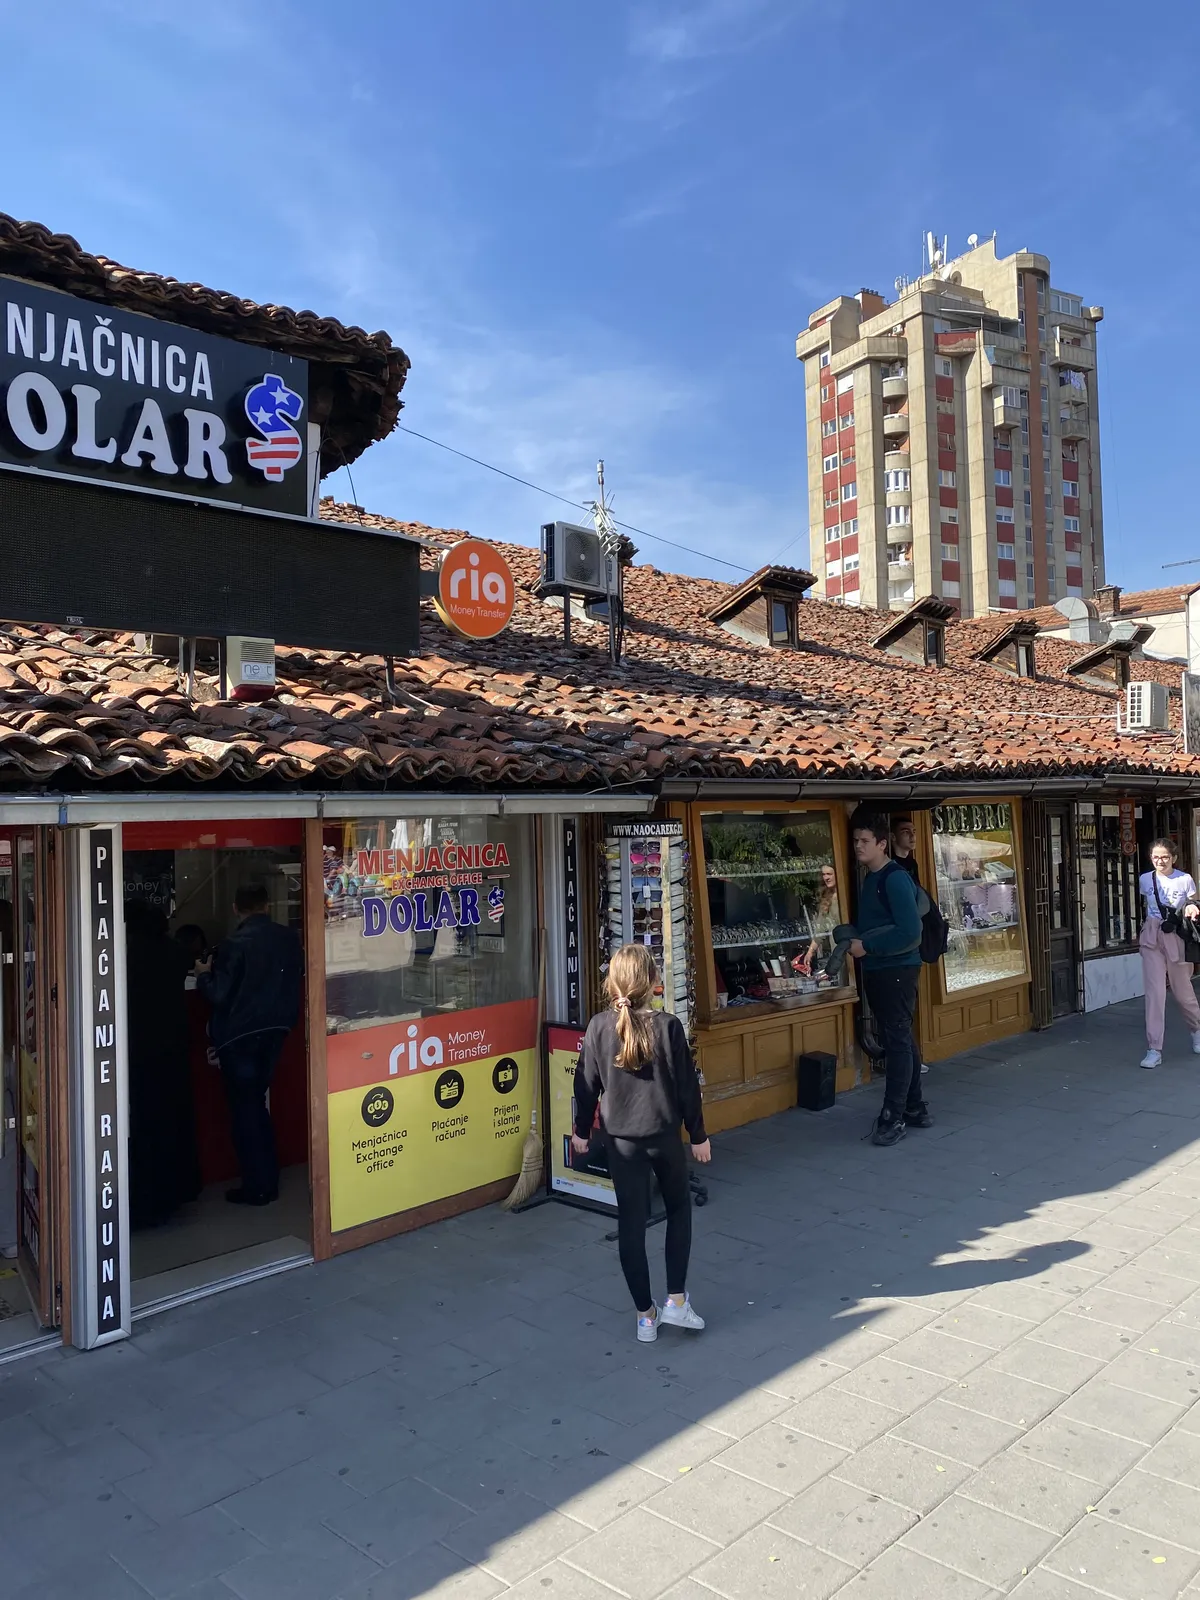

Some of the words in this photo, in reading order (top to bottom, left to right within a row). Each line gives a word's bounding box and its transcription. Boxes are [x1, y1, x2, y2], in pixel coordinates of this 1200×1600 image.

[7, 302, 213, 400] NJAČNICA
[7, 371, 232, 484] OLAR
[450, 552, 506, 604] ria
[450, 604, 476, 617] Money
[476, 606, 506, 619] Transfer
[934, 804, 1006, 833] SREBRO
[357, 839, 510, 876] MENJAČNICA
[392, 875, 448, 891] EXCHANGE
[450, 872, 483, 886] OFFICE
[361, 888, 481, 937] DOLAR
[566, 830, 577, 999] PLAĆANJE
[96, 846, 114, 1084] PLAĆANJE
[448, 1029, 486, 1046] Money
[389, 1024, 444, 1075] ria
[448, 1043, 492, 1061] Transfer
[493, 1103, 519, 1117] Prijem
[497, 1114, 521, 1127] slanje
[431, 1114, 469, 1131] Plaćanje
[494, 1126, 520, 1139] novca
[352, 1129, 408, 1151] Menjačnica
[435, 1126, 466, 1142] računa
[356, 1143, 404, 1164] Exchange
[366, 1158, 395, 1174] office
[100, 1112, 115, 1320] RAČUNA
